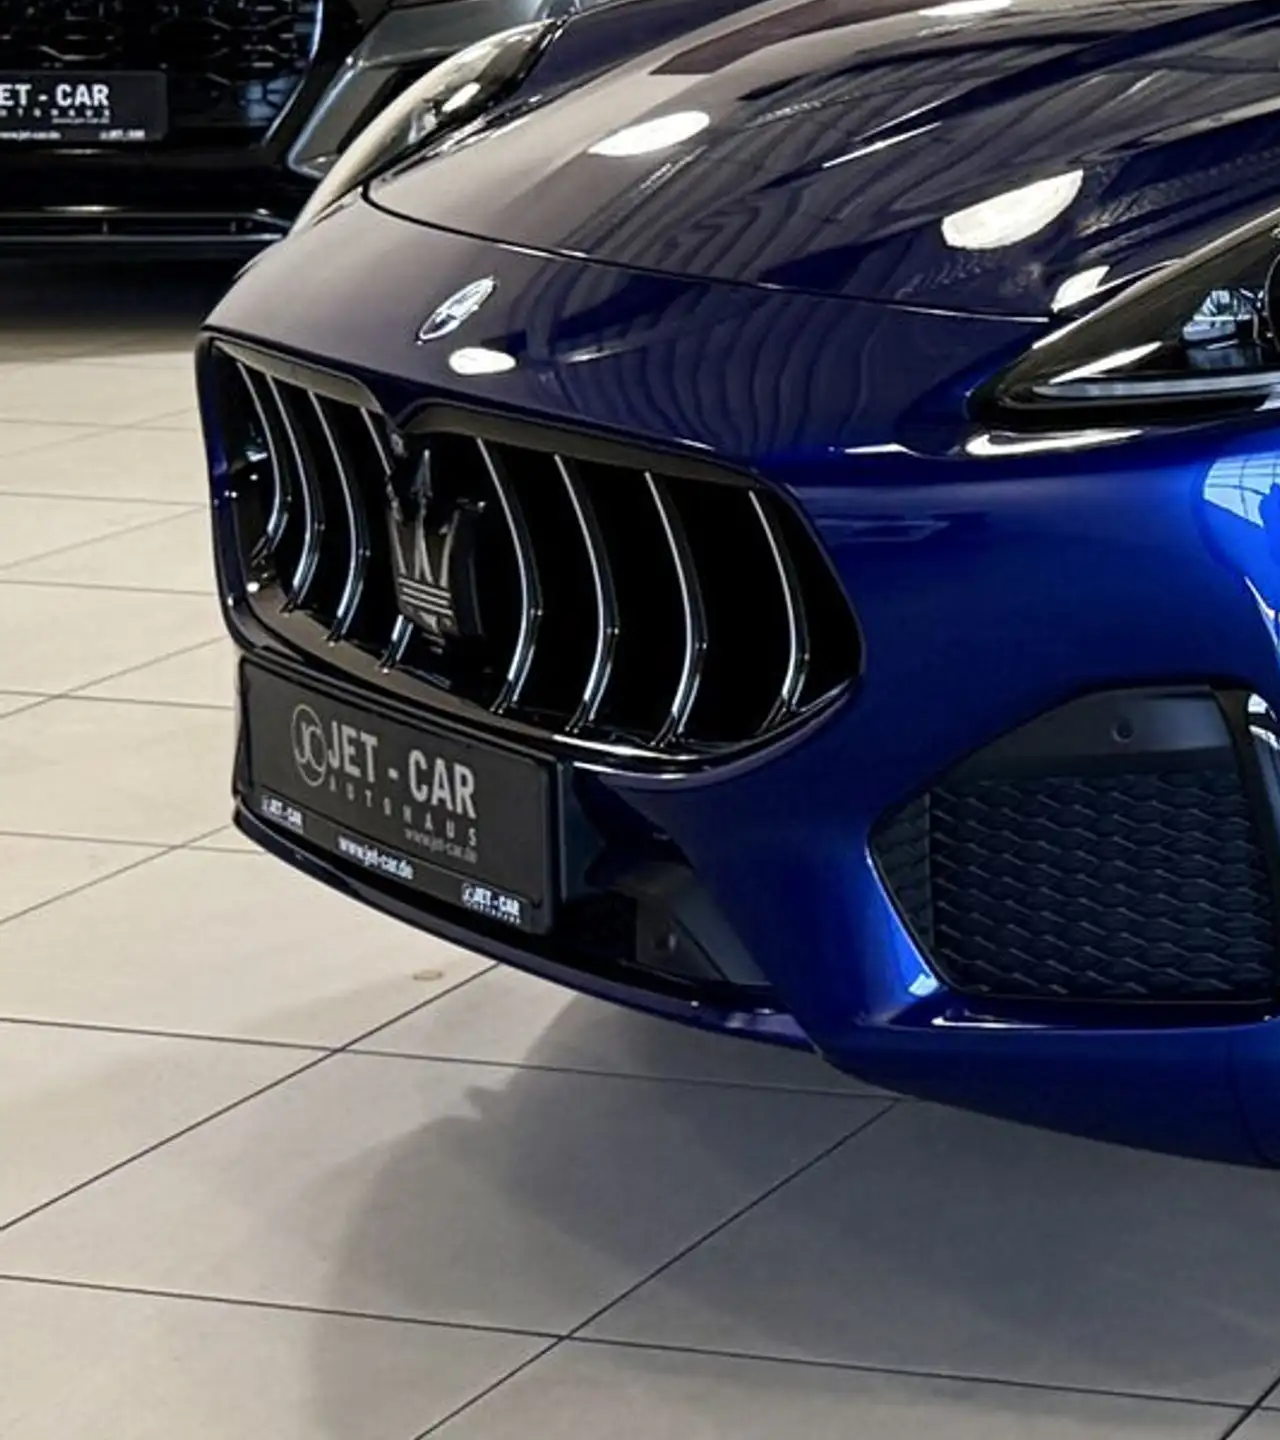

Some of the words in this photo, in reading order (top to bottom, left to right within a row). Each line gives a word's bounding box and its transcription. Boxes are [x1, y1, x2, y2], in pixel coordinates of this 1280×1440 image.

[0, 84, 32, 107] ET
[55, 83, 110, 107] CAR
[328, 719, 379, 784] JET
[407, 748, 477, 820] CAR
